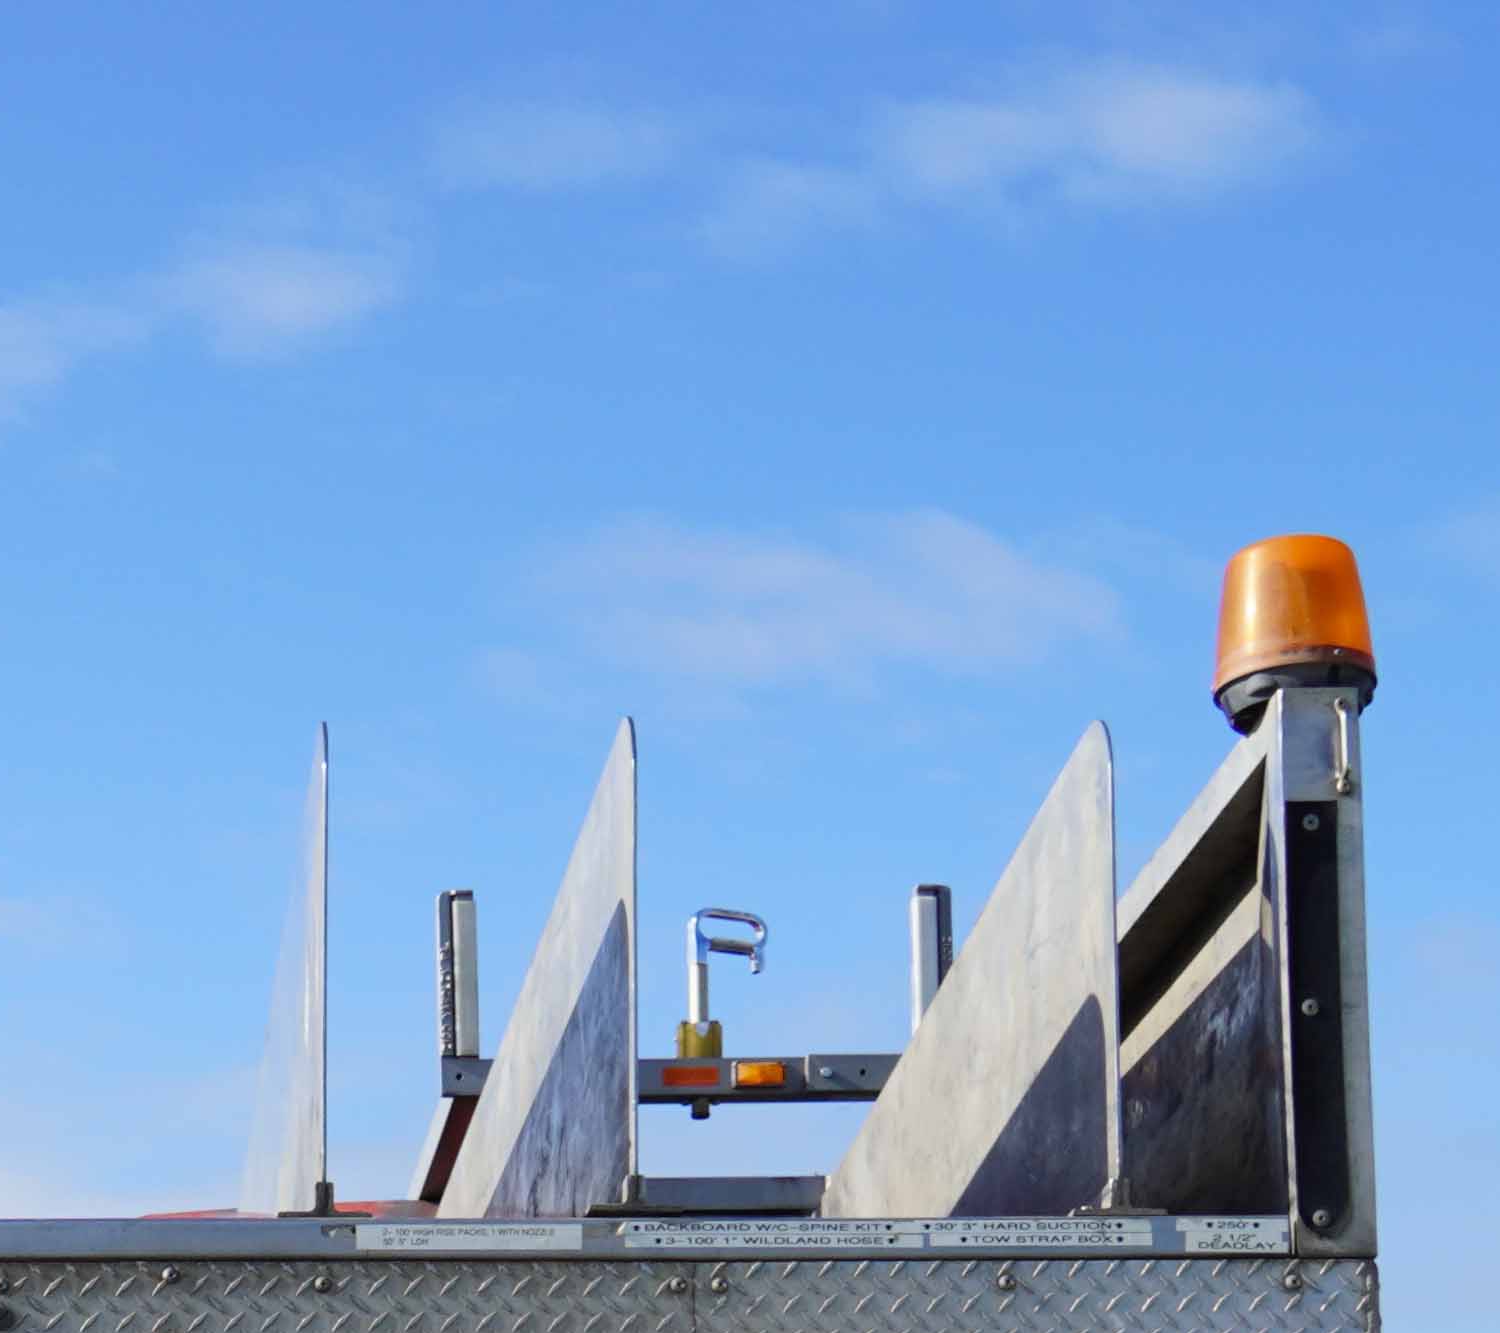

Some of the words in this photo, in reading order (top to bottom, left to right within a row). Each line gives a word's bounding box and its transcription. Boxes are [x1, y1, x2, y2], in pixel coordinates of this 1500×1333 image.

[644, 1223, 749, 1232] BACKBOARD
[856, 1223, 881, 1231] KIT
[984, 1222, 1031, 1230] HARD
[1036, 1222, 1112, 1230] SUCTION
[744, 1236, 831, 1245] WILDLAND
[837, 1236, 884, 1245] HOSE
[972, 1235, 1010, 1243] TOW
[1016, 1235, 1072, 1243] STRAP
[1078, 1235, 1112, 1243] BOX
[1213, 1233, 1222, 1241] 2
[1198, 1241, 1276, 1250] DEADLAY
